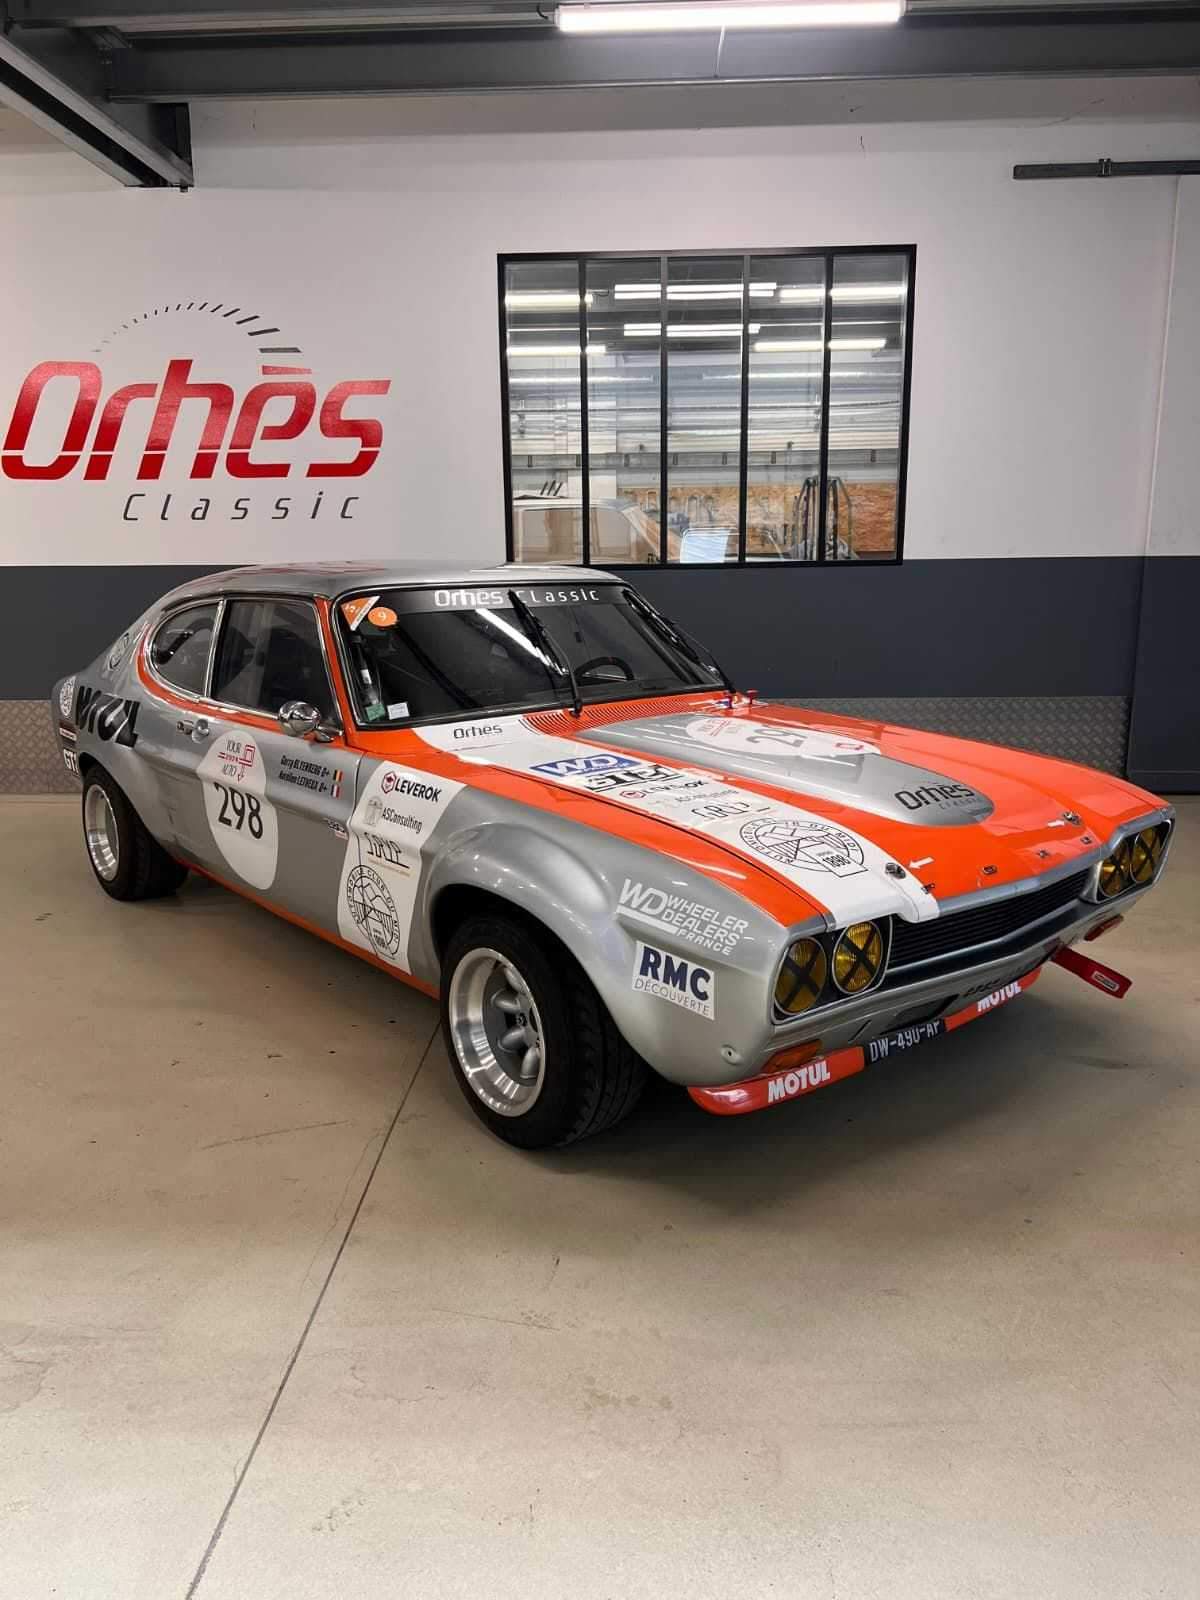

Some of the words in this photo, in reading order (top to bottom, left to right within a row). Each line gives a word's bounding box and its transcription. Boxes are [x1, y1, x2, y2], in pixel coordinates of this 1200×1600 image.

[1, 358, 391, 480] Orhès
[122, 490, 360, 521] Classic
[394, 778, 441, 802] LEVEROK
[213, 781, 263, 839] 298
[619, 878, 669, 915] WD
[667, 894, 749, 934] WHEELER
[661, 909, 740, 947] DEALERS
[677, 928, 733, 956] FRANCE
[639, 945, 711, 1001] RMC
[768, 1060, 831, 1103] MOTUL
